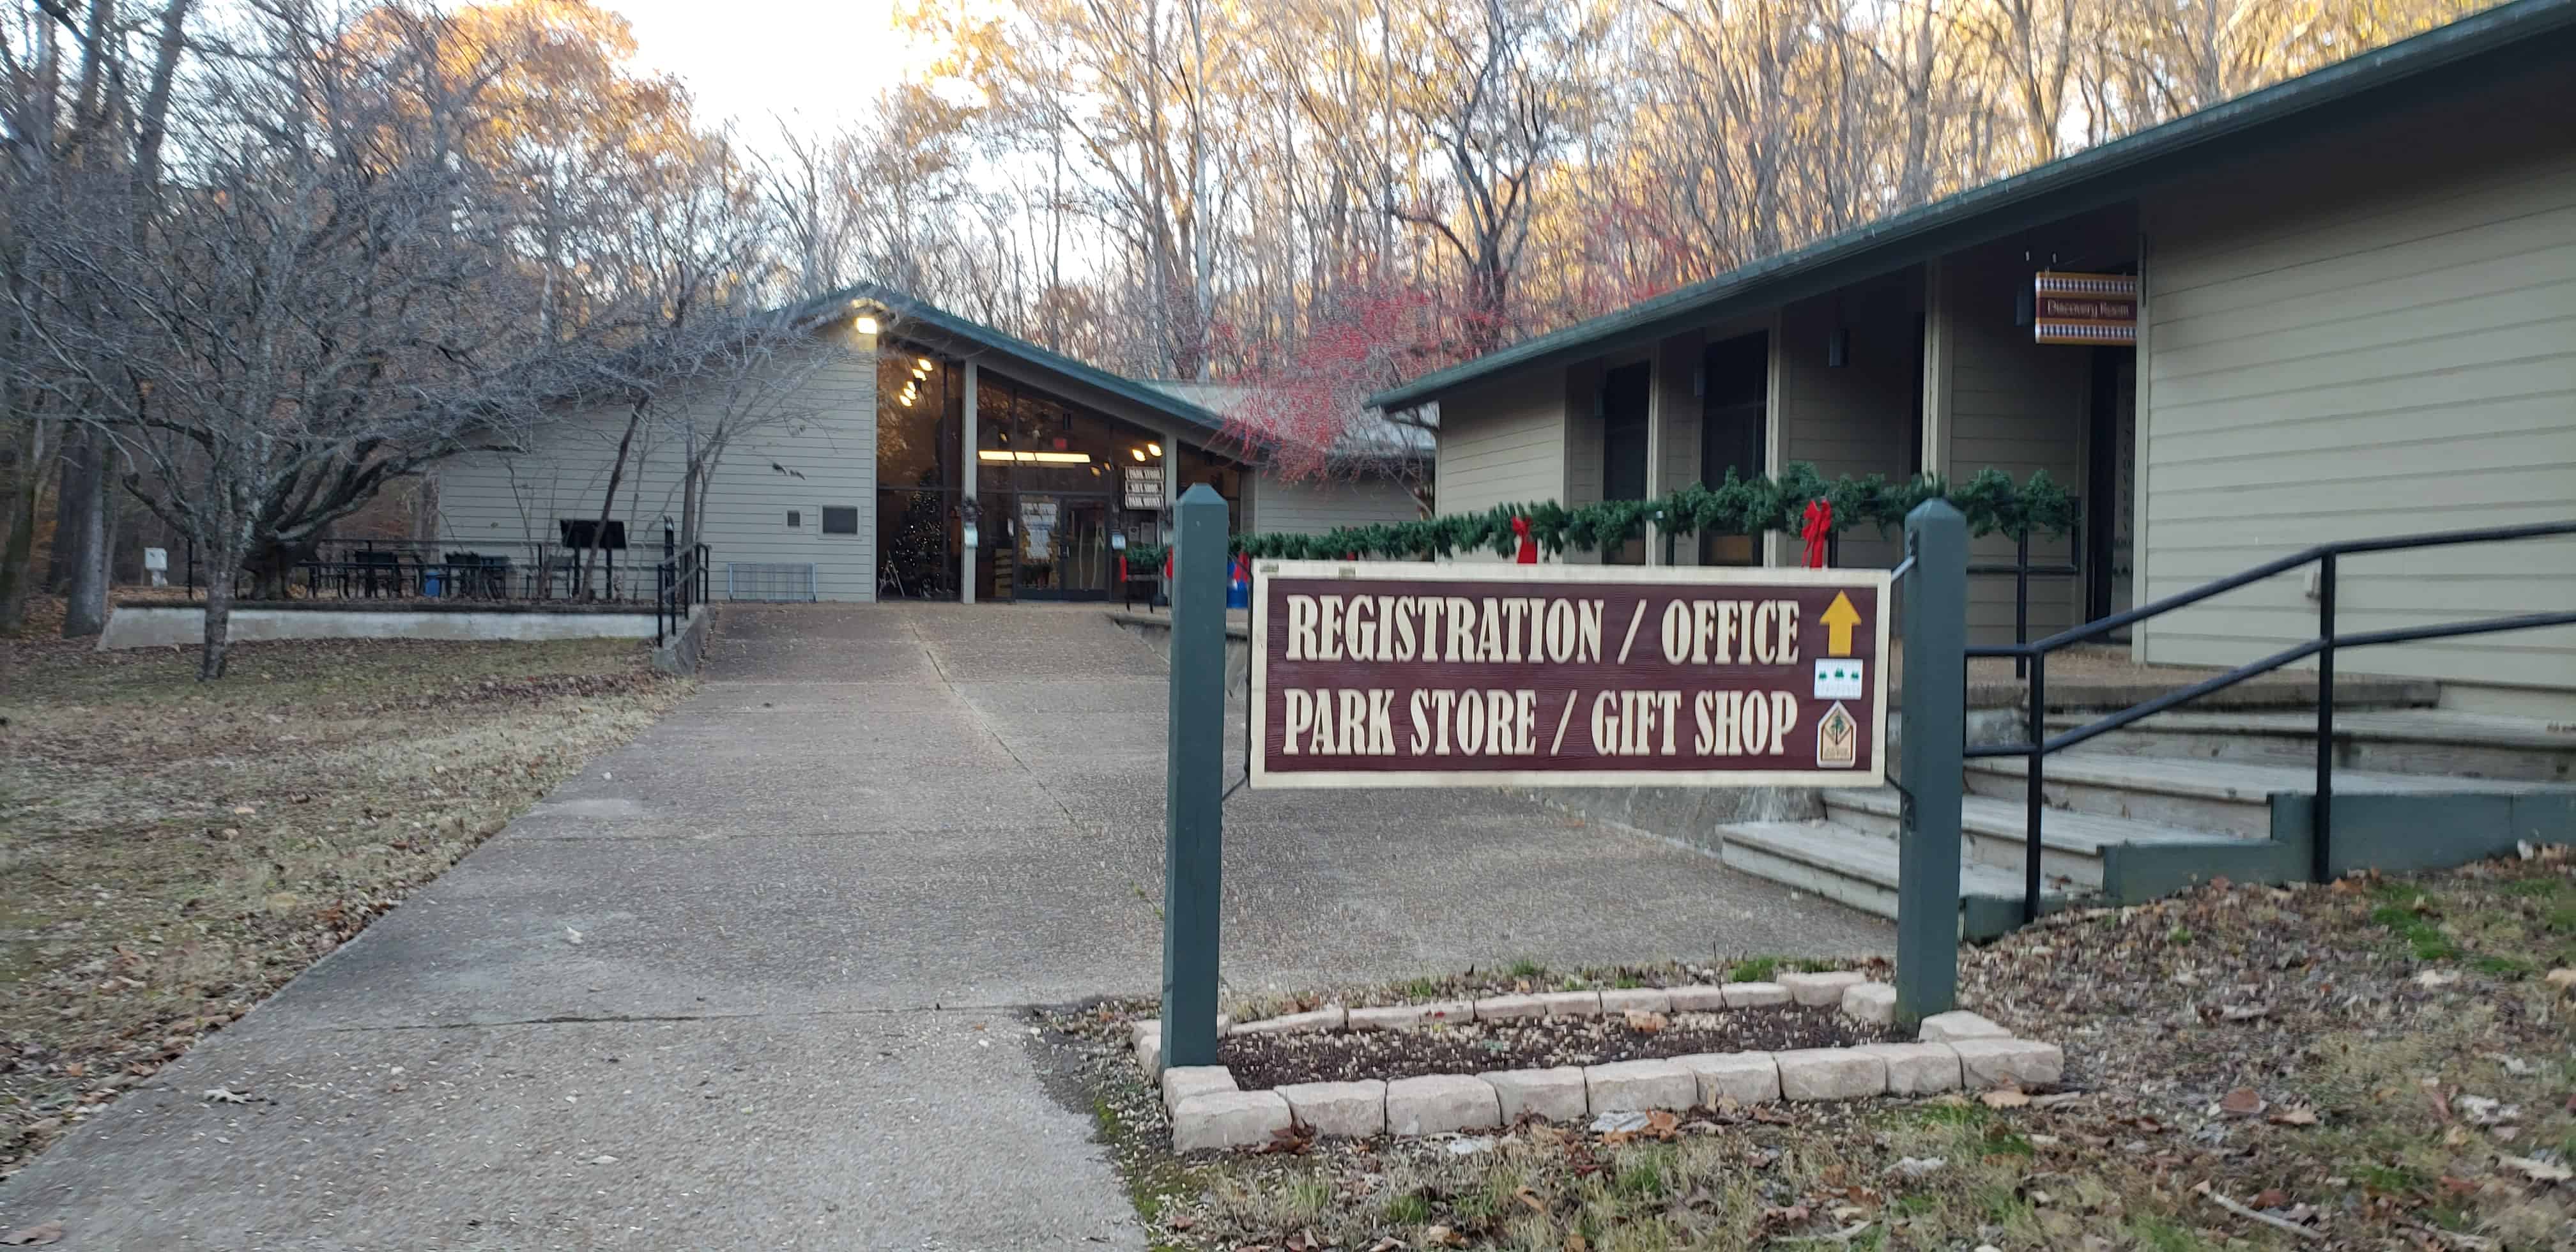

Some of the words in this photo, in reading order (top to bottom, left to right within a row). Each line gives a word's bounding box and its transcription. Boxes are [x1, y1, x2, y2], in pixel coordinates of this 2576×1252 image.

[2047, 299, 2098, 319] Discovery
[2100, 302, 2129, 317] Room
[1285, 595, 1604, 663] REGISTRATION
[1618, 599, 1647, 664] /
[1662, 599, 1800, 664] OFFICE
[1283, 689, 1396, 755] PARK
[1410, 689, 1537, 756] STORE
[1551, 689, 1577, 755] /
[1591, 690, 1682, 756] GIFT
[1694, 690, 1798, 756] SHOP
